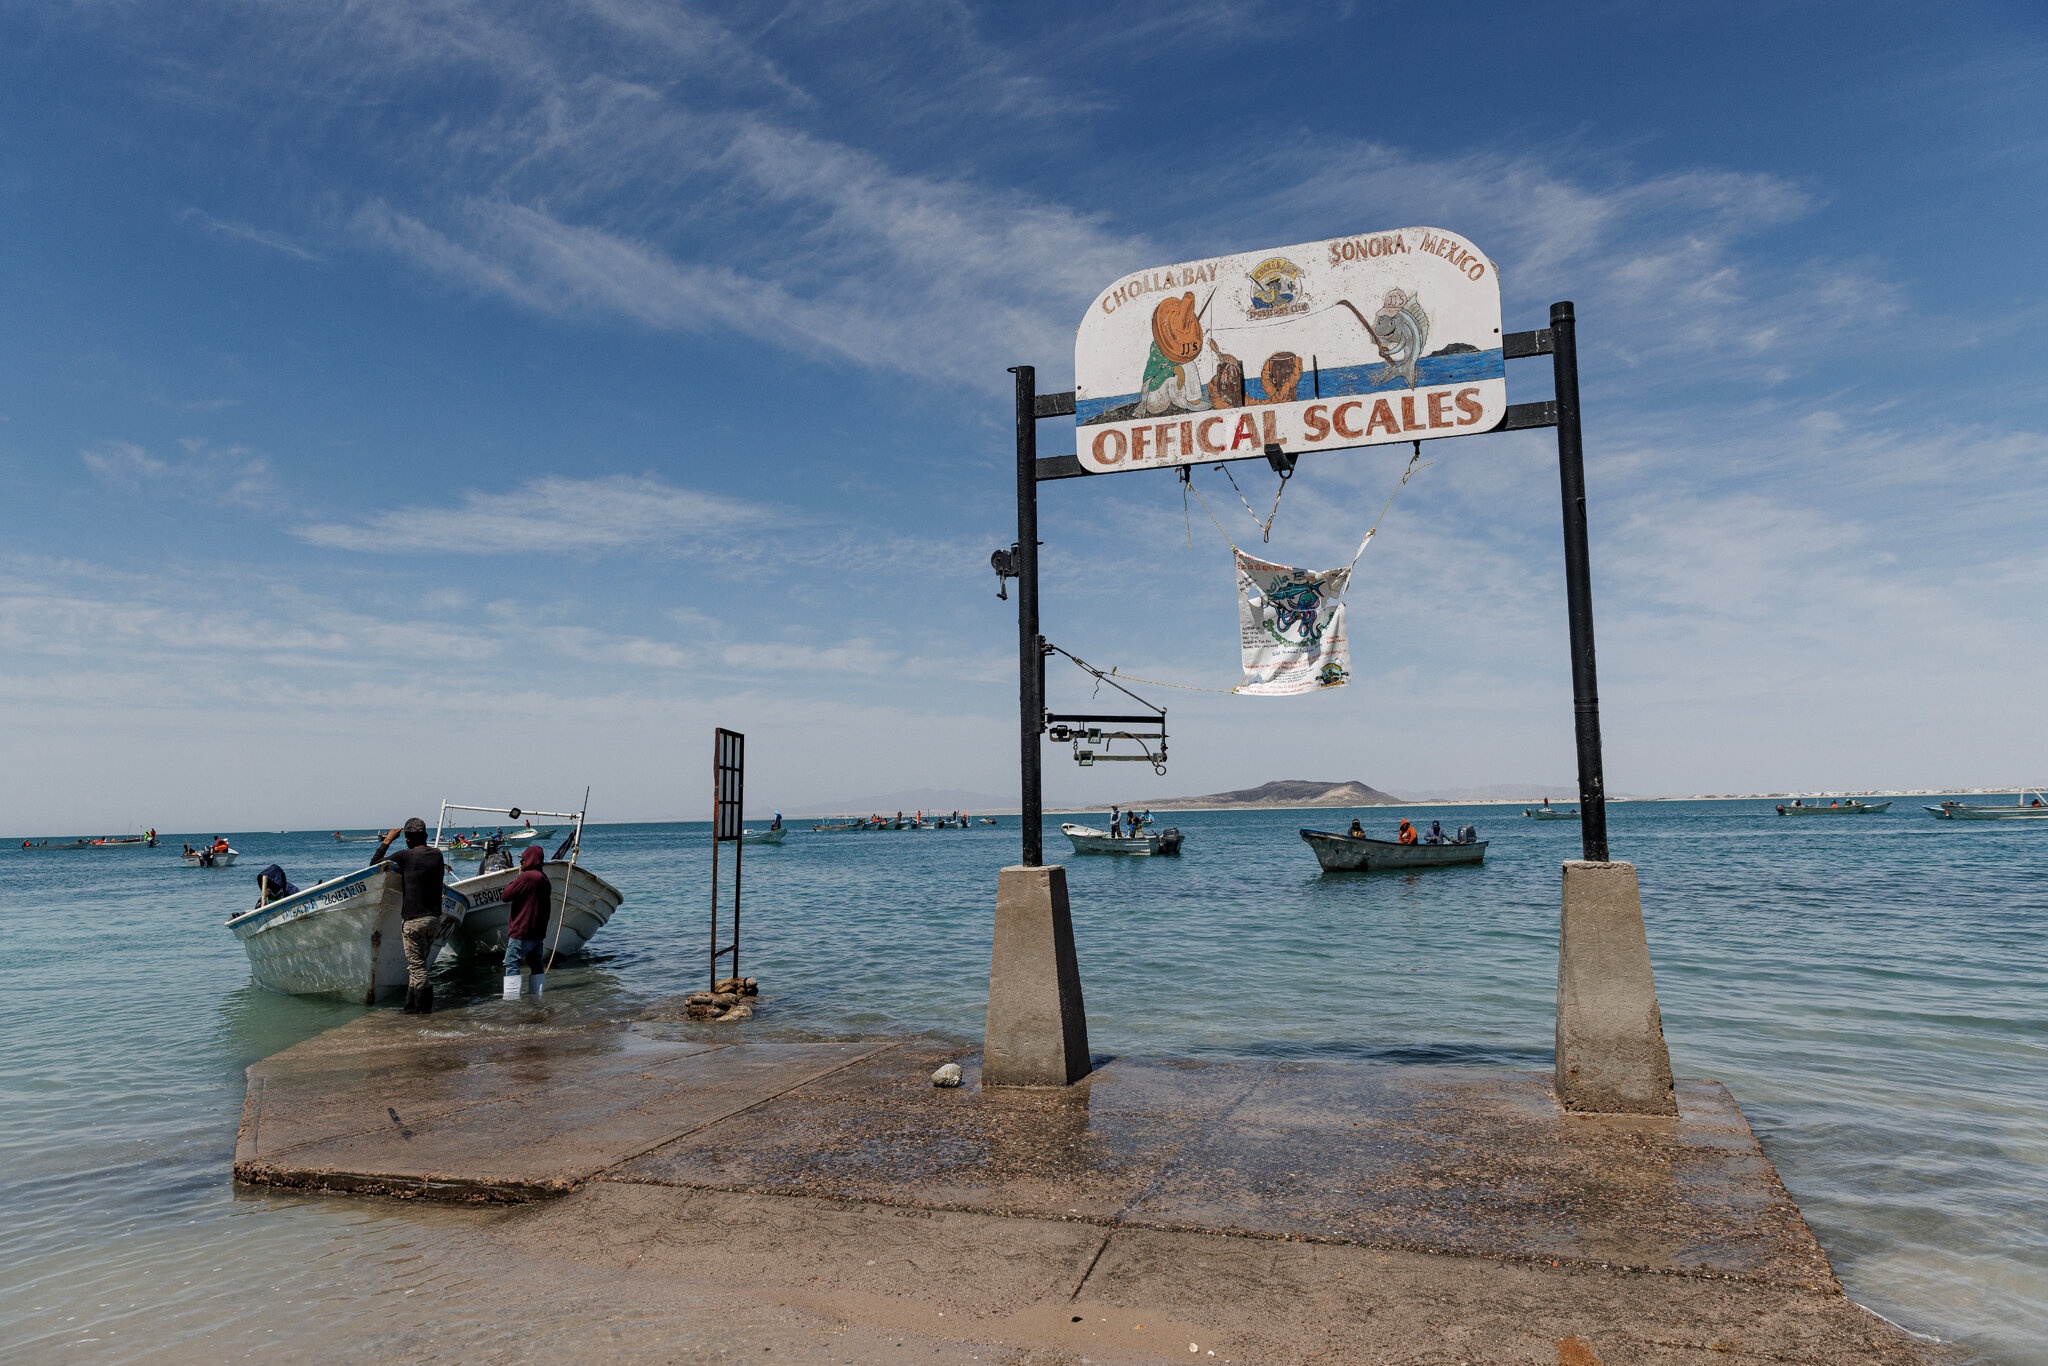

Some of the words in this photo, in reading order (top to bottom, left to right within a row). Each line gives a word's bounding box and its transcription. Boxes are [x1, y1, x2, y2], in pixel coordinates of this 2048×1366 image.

[1330, 233, 1412, 264] SONORA,
[1419, 232, 1485, 282] MEXICO
[1102, 270, 1176, 314] CHOLLA
[1181, 263, 1219, 286] BAY
[1092, 410, 1288, 465] OFFICAL
[1303, 388, 1484, 442] SCALES
[472, 887, 505, 905] PESQUE
